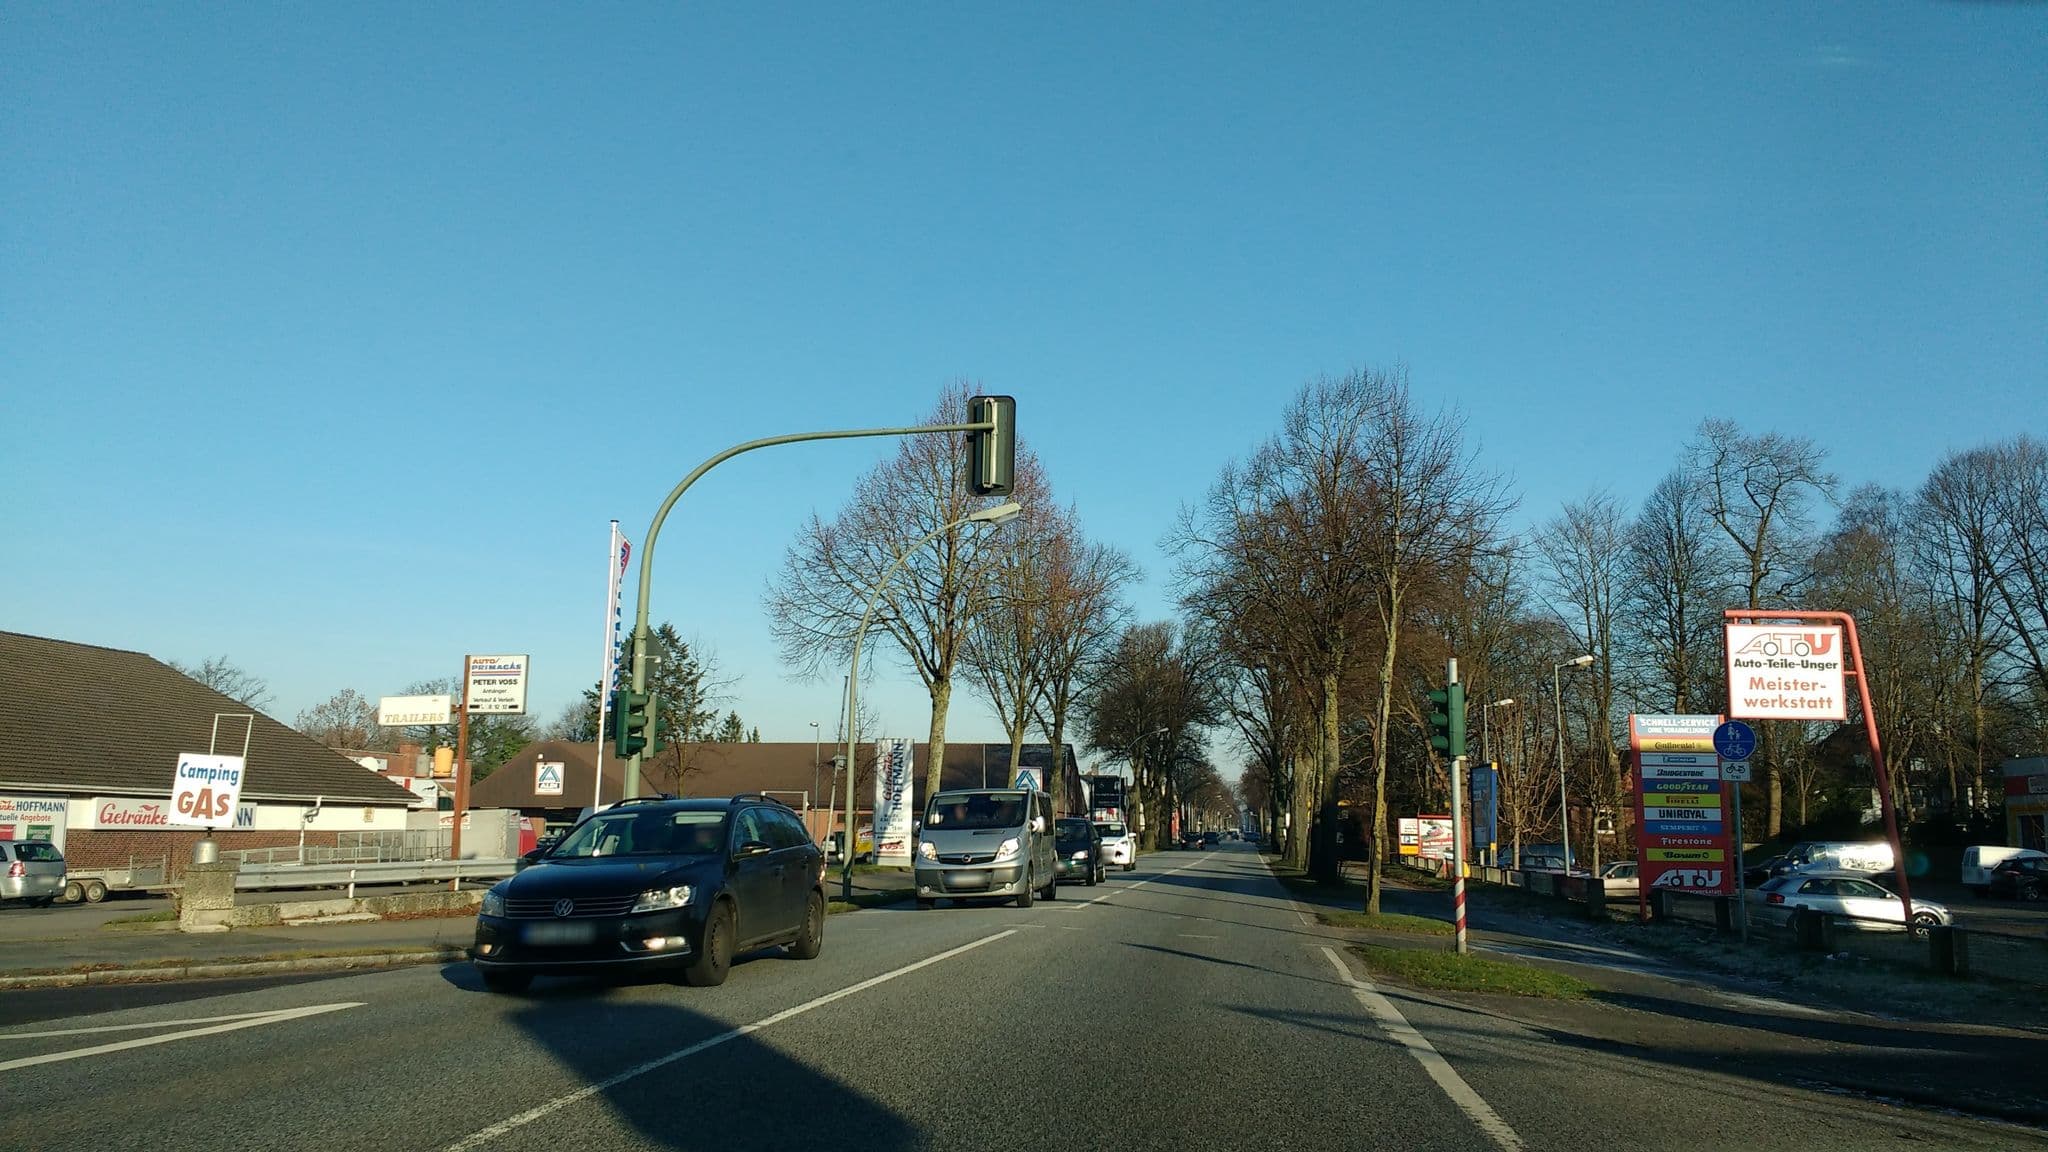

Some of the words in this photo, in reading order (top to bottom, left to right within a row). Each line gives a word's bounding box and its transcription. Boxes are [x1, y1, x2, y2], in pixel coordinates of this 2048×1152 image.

[1734, 658, 1839, 671] Auto-Teile-Unger
[1749, 676, 1827, 691] Meister-
[1744, 694, 1833, 709] werkstatt
[384, 712, 445, 723] TRAILERS
[1640, 719, 1716, 727] SCHNELL-SERVICE
[1654, 741, 1697, 750] Continental
[180, 762, 240, 786] Camping
[892, 743, 904, 811] HOFFMANN
[1656, 768, 1705, 777] BRIDGESTONE
[1656, 782, 1710, 791] GOODYEAR
[16, 801, 66, 812] HOFFMANN
[177, 788, 230, 820] GAS
[20, 814, 52, 823] Angebote
[100, 803, 168, 826] Getränke
[1658, 809, 1708, 819] UNIROYAL
[1660, 837, 1713, 846] Firestone
[1663, 851, 1700, 859] Barum
